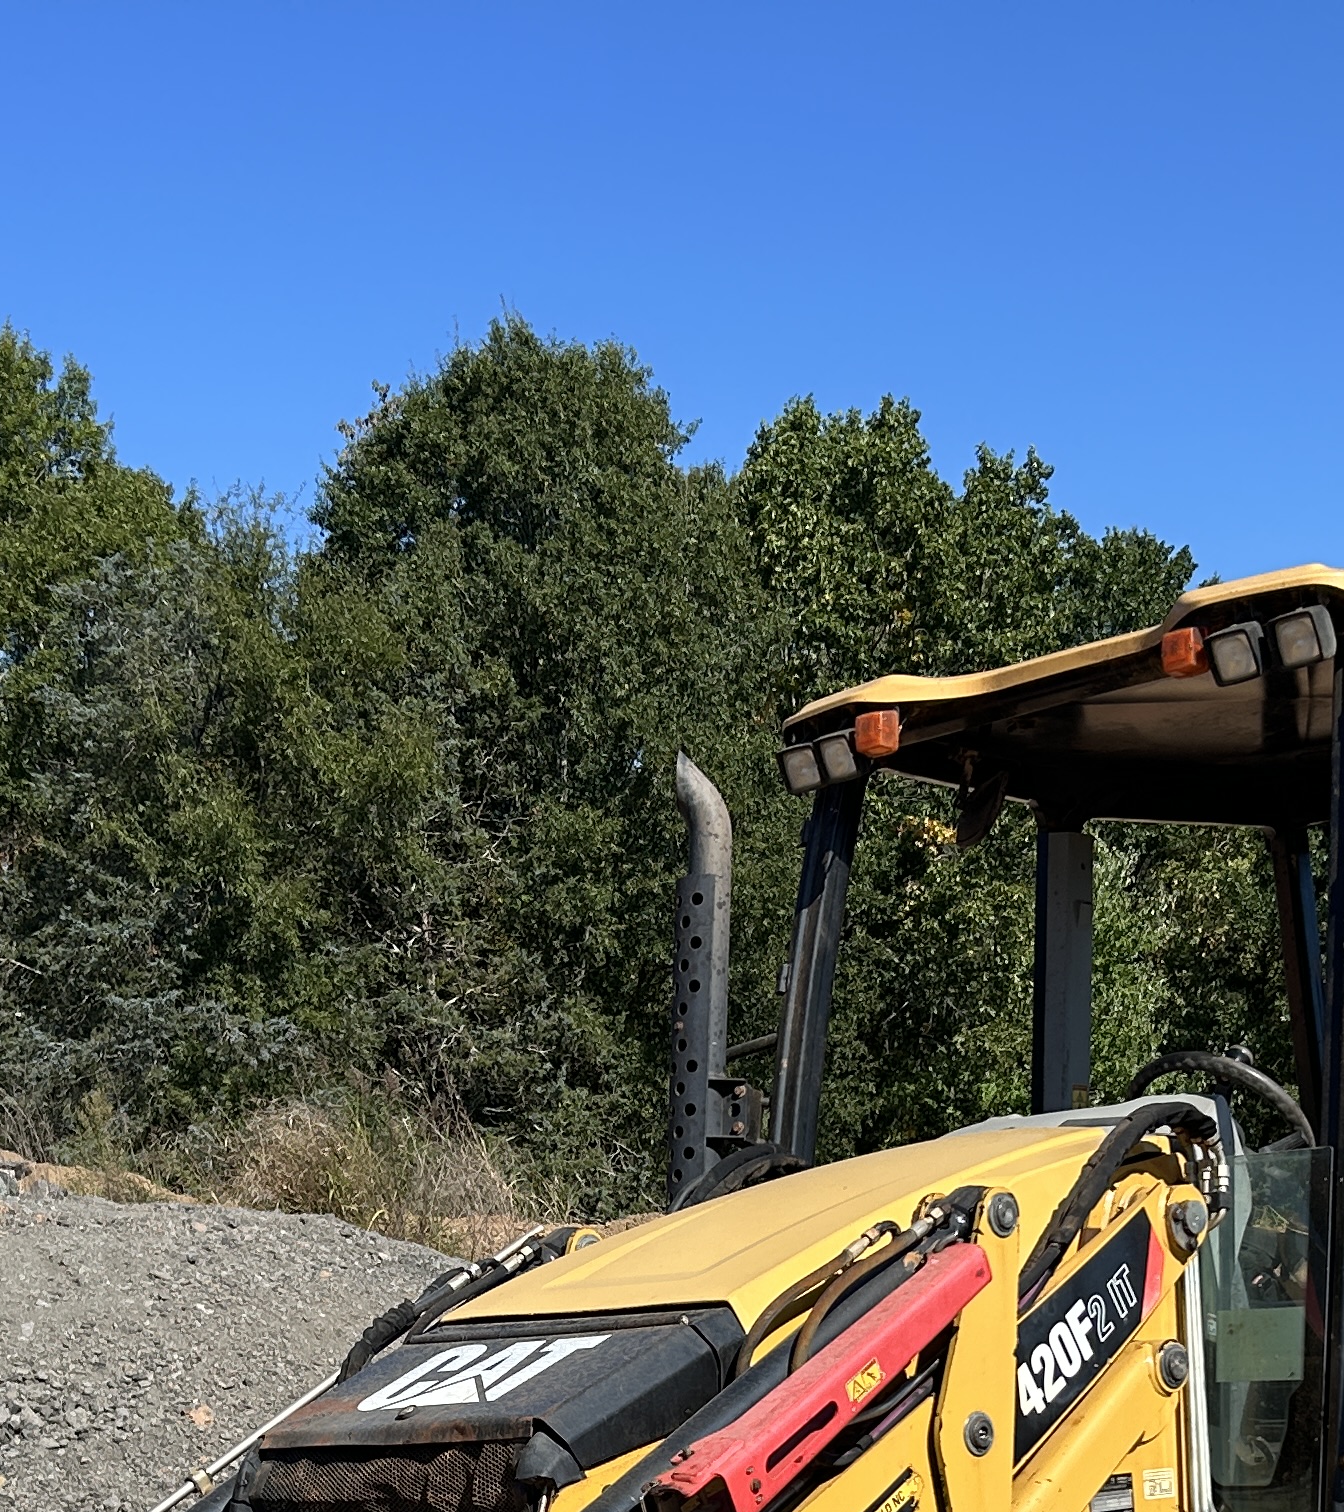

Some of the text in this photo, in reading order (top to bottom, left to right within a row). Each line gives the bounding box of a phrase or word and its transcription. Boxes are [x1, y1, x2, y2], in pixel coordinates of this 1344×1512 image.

[1107, 1263, 1138, 1319] IT
[357, 1334, 613, 1412] CAT
[891, 1490, 905, 1507] NC
